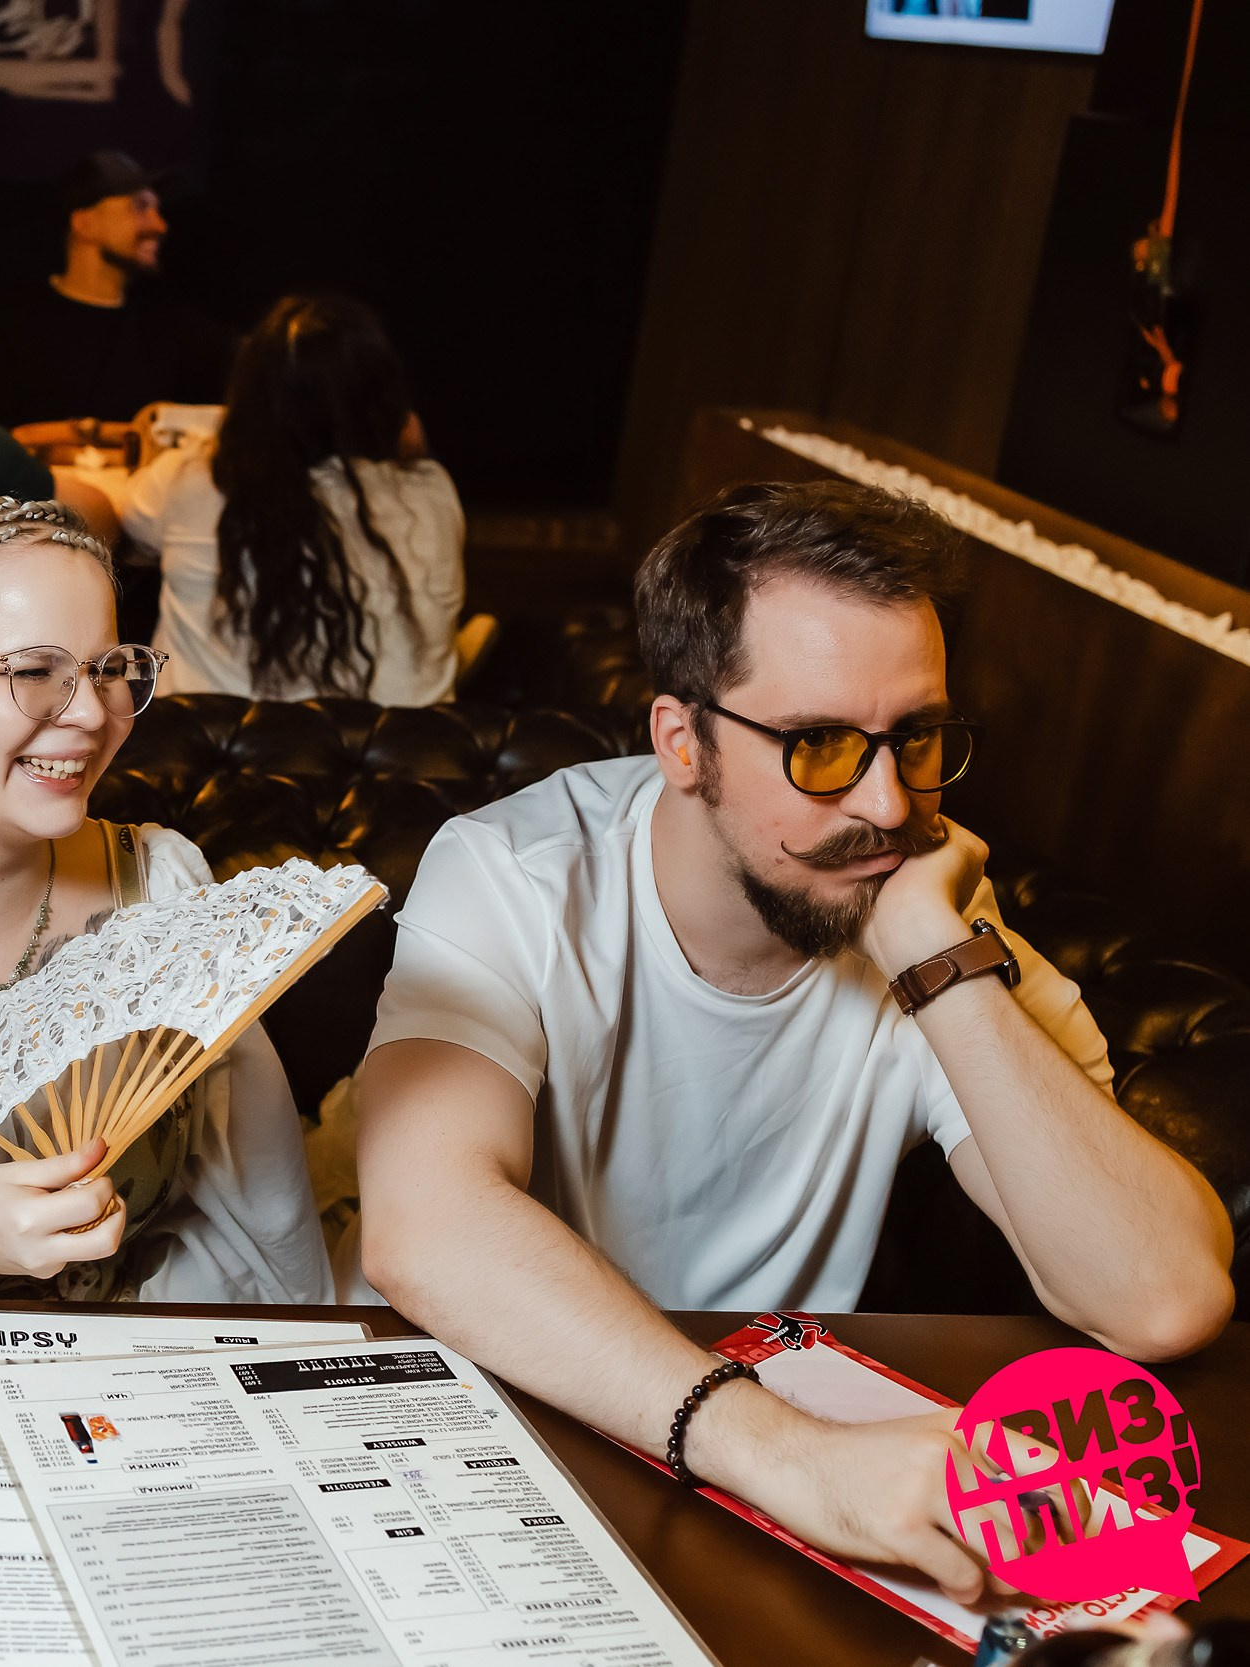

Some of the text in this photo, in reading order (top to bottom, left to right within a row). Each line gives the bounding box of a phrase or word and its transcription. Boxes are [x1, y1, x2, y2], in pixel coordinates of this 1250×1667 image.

[322, 1377, 357, 1385] SHOTS
[370, 1439, 418, 1448] WHISKEY
[128, 1461, 179, 1470] НАПИТКИ
[468, 1458, 514, 1468] TEQUILA
[138, 1483, 193, 1493] ЛИМОНАД
[323, 1480, 384, 1491] VERMOUTH
[522, 1516, 560, 1525] VODKA
[524, 1597, 602, 1611] BOTTLED BEER
[498, 1634, 567, 1649] DRAFT BEER
